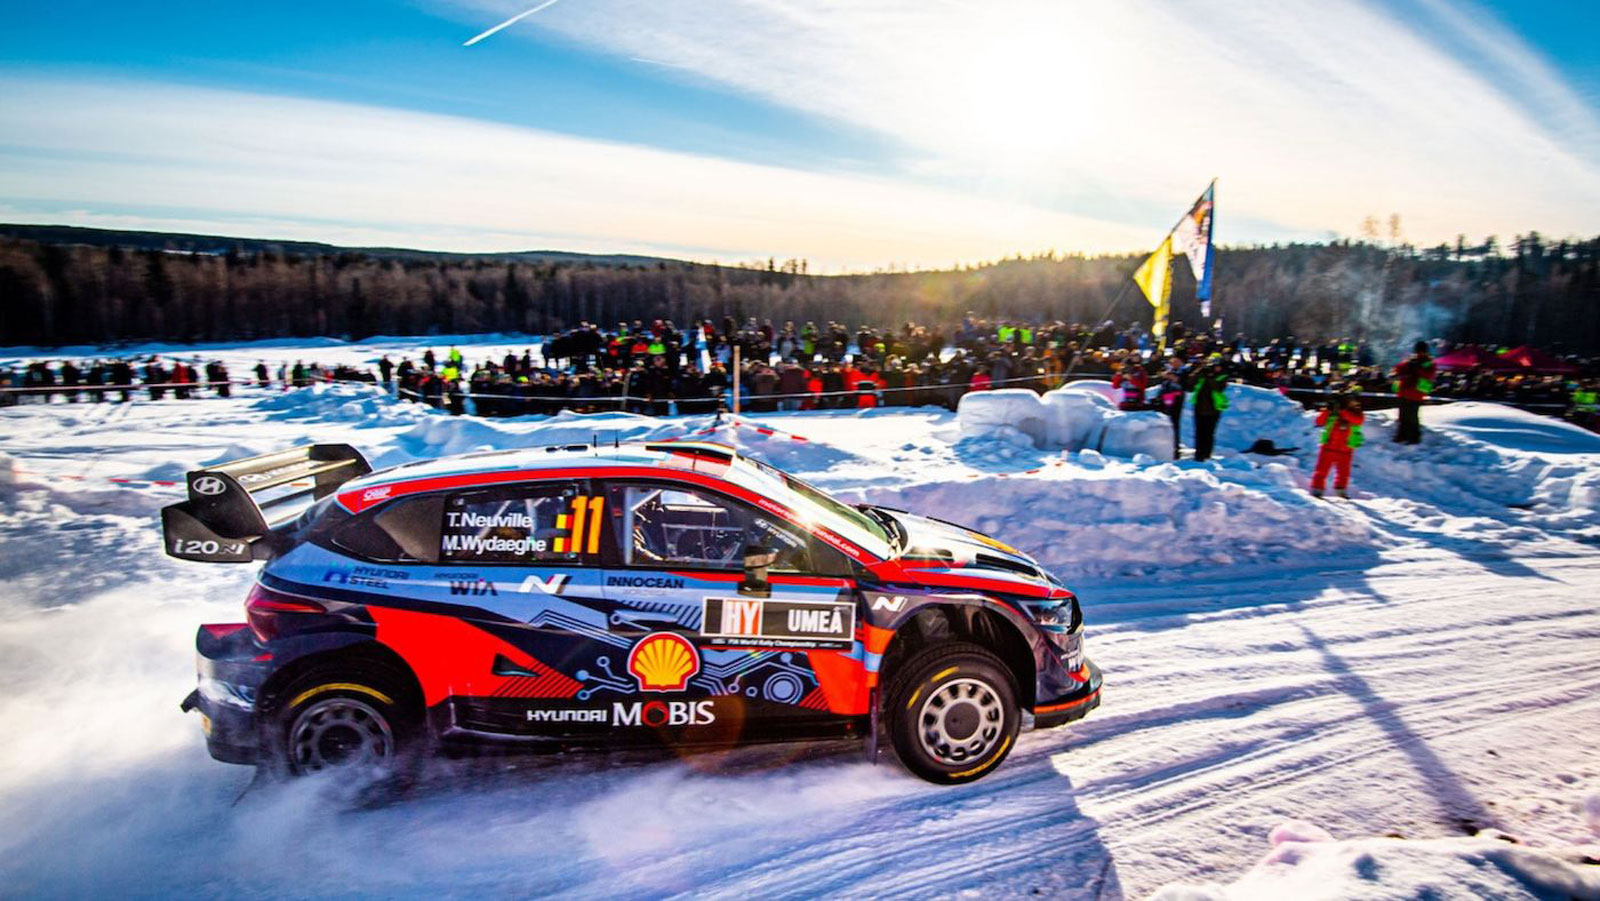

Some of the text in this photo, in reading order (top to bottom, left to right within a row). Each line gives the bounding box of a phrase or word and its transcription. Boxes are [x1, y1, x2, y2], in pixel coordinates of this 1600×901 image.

[446, 511, 533, 529] T.Neuville
[570, 495, 605, 554] 11
[174, 538, 219, 555] i20
[442, 534, 547, 555] M.Wydaeghe
[354, 566, 410, 580] HYUNDAI
[607, 575, 685, 589] INNOCEAN
[450, 579, 498, 596] WIA
[787, 606, 843, 634] UMEÅ
[526, 700, 716, 727] HYUNDAI MOBIS
